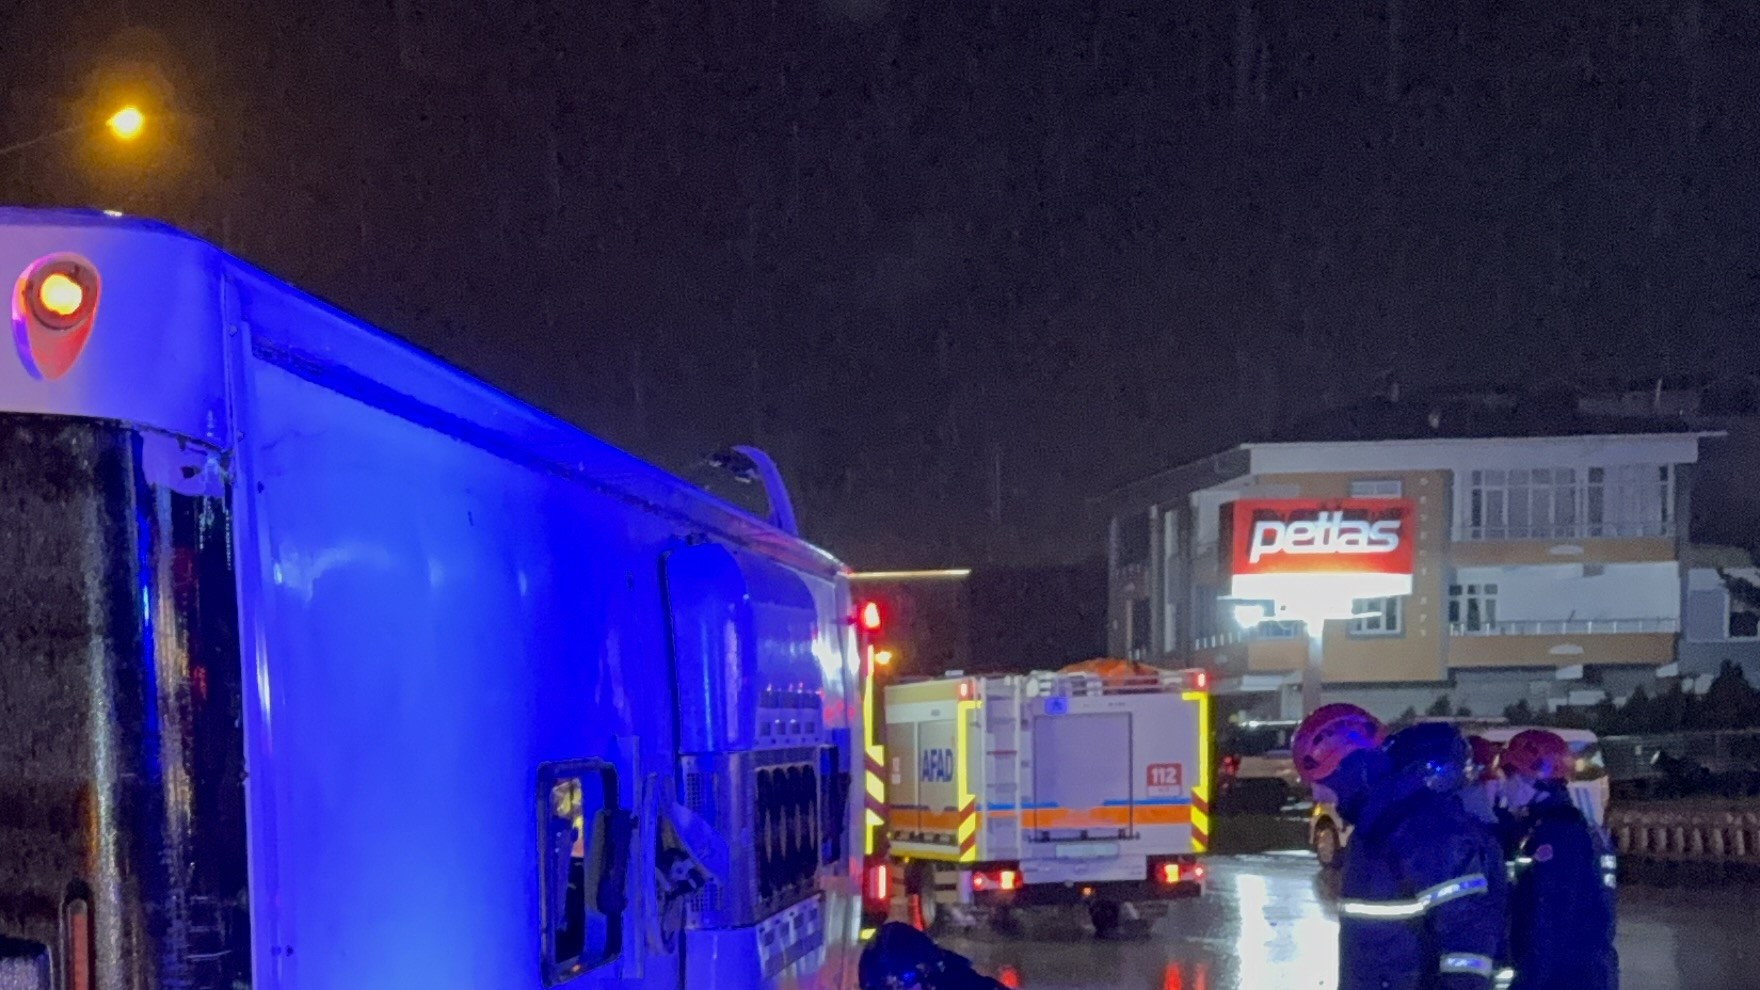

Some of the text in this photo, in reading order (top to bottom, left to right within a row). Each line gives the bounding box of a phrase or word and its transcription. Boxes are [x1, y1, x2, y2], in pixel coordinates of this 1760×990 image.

[1249, 511, 1401, 563] petlas
[922, 748, 953, 782] AFAD
[1151, 767, 1177, 784] 112
